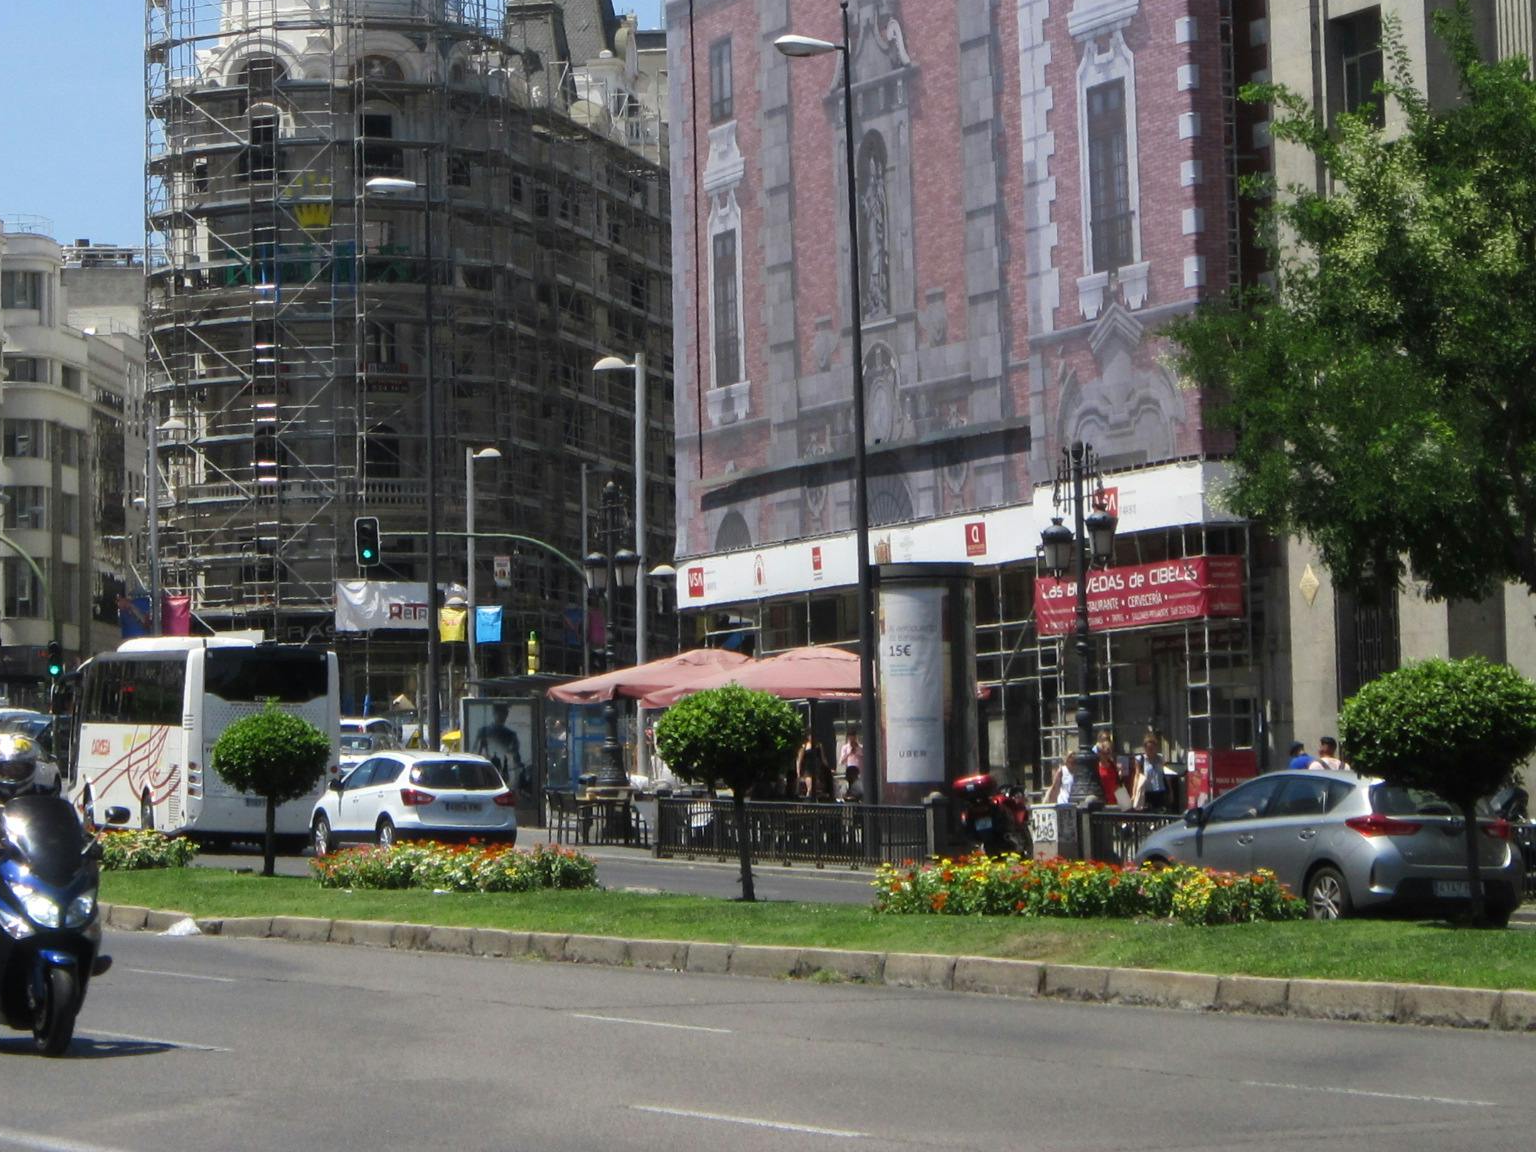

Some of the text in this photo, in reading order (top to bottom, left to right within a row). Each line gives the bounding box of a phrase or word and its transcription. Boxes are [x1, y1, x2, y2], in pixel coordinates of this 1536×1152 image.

[1067, 574, 1124, 596] BVEDAS
[1128, 572, 1144, 588] de
[889, 644, 912, 657] 15€
